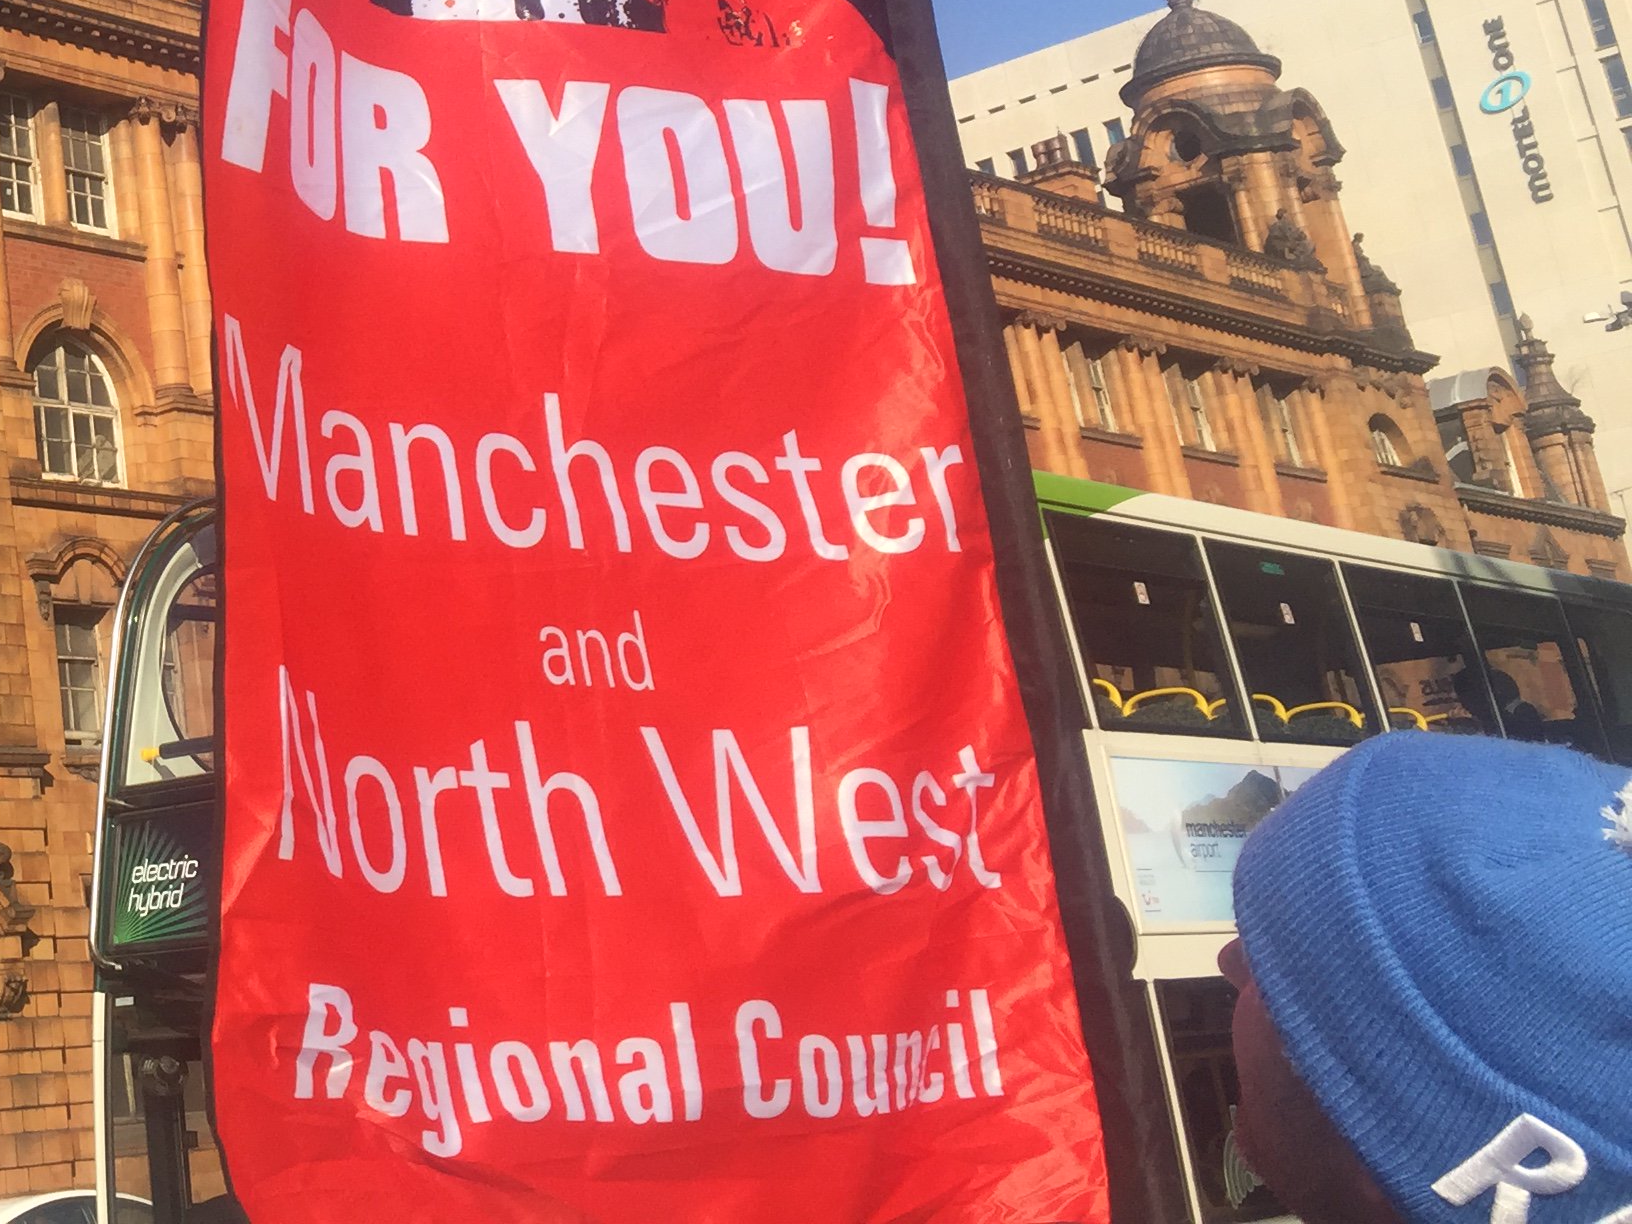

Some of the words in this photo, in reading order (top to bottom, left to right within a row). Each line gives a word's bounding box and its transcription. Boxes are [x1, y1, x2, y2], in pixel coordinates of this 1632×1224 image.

[493, 77, 918, 286] YOU!
[224, 313, 965, 563] Manchester
[539, 609, 655, 692] and
[278, 664, 624, 899] North
[639, 724, 1003, 898] West
[127, 883, 184, 917] hybrid
[131, 854, 199, 884] electric
[294, 982, 705, 1158] Regional
[734, 988, 1005, 1119] Council
[1431, 1112, 1632, 1224] R
